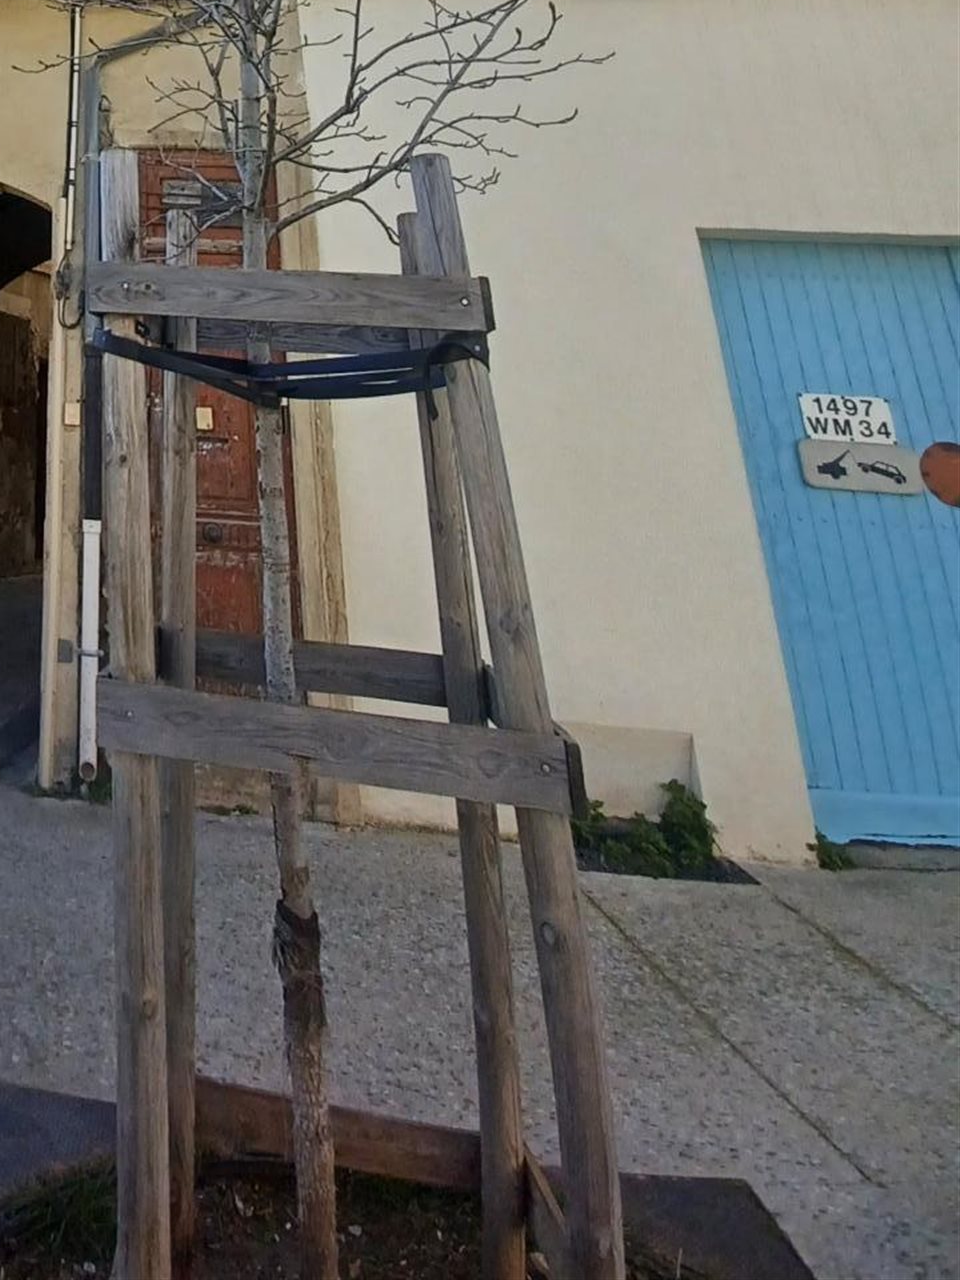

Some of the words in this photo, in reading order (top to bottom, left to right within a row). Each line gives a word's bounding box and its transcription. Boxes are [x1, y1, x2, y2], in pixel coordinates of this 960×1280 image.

[812, 397, 873, 417] 1497
[806, 416, 854, 437] WM
[858, 420, 892, 439] 34
